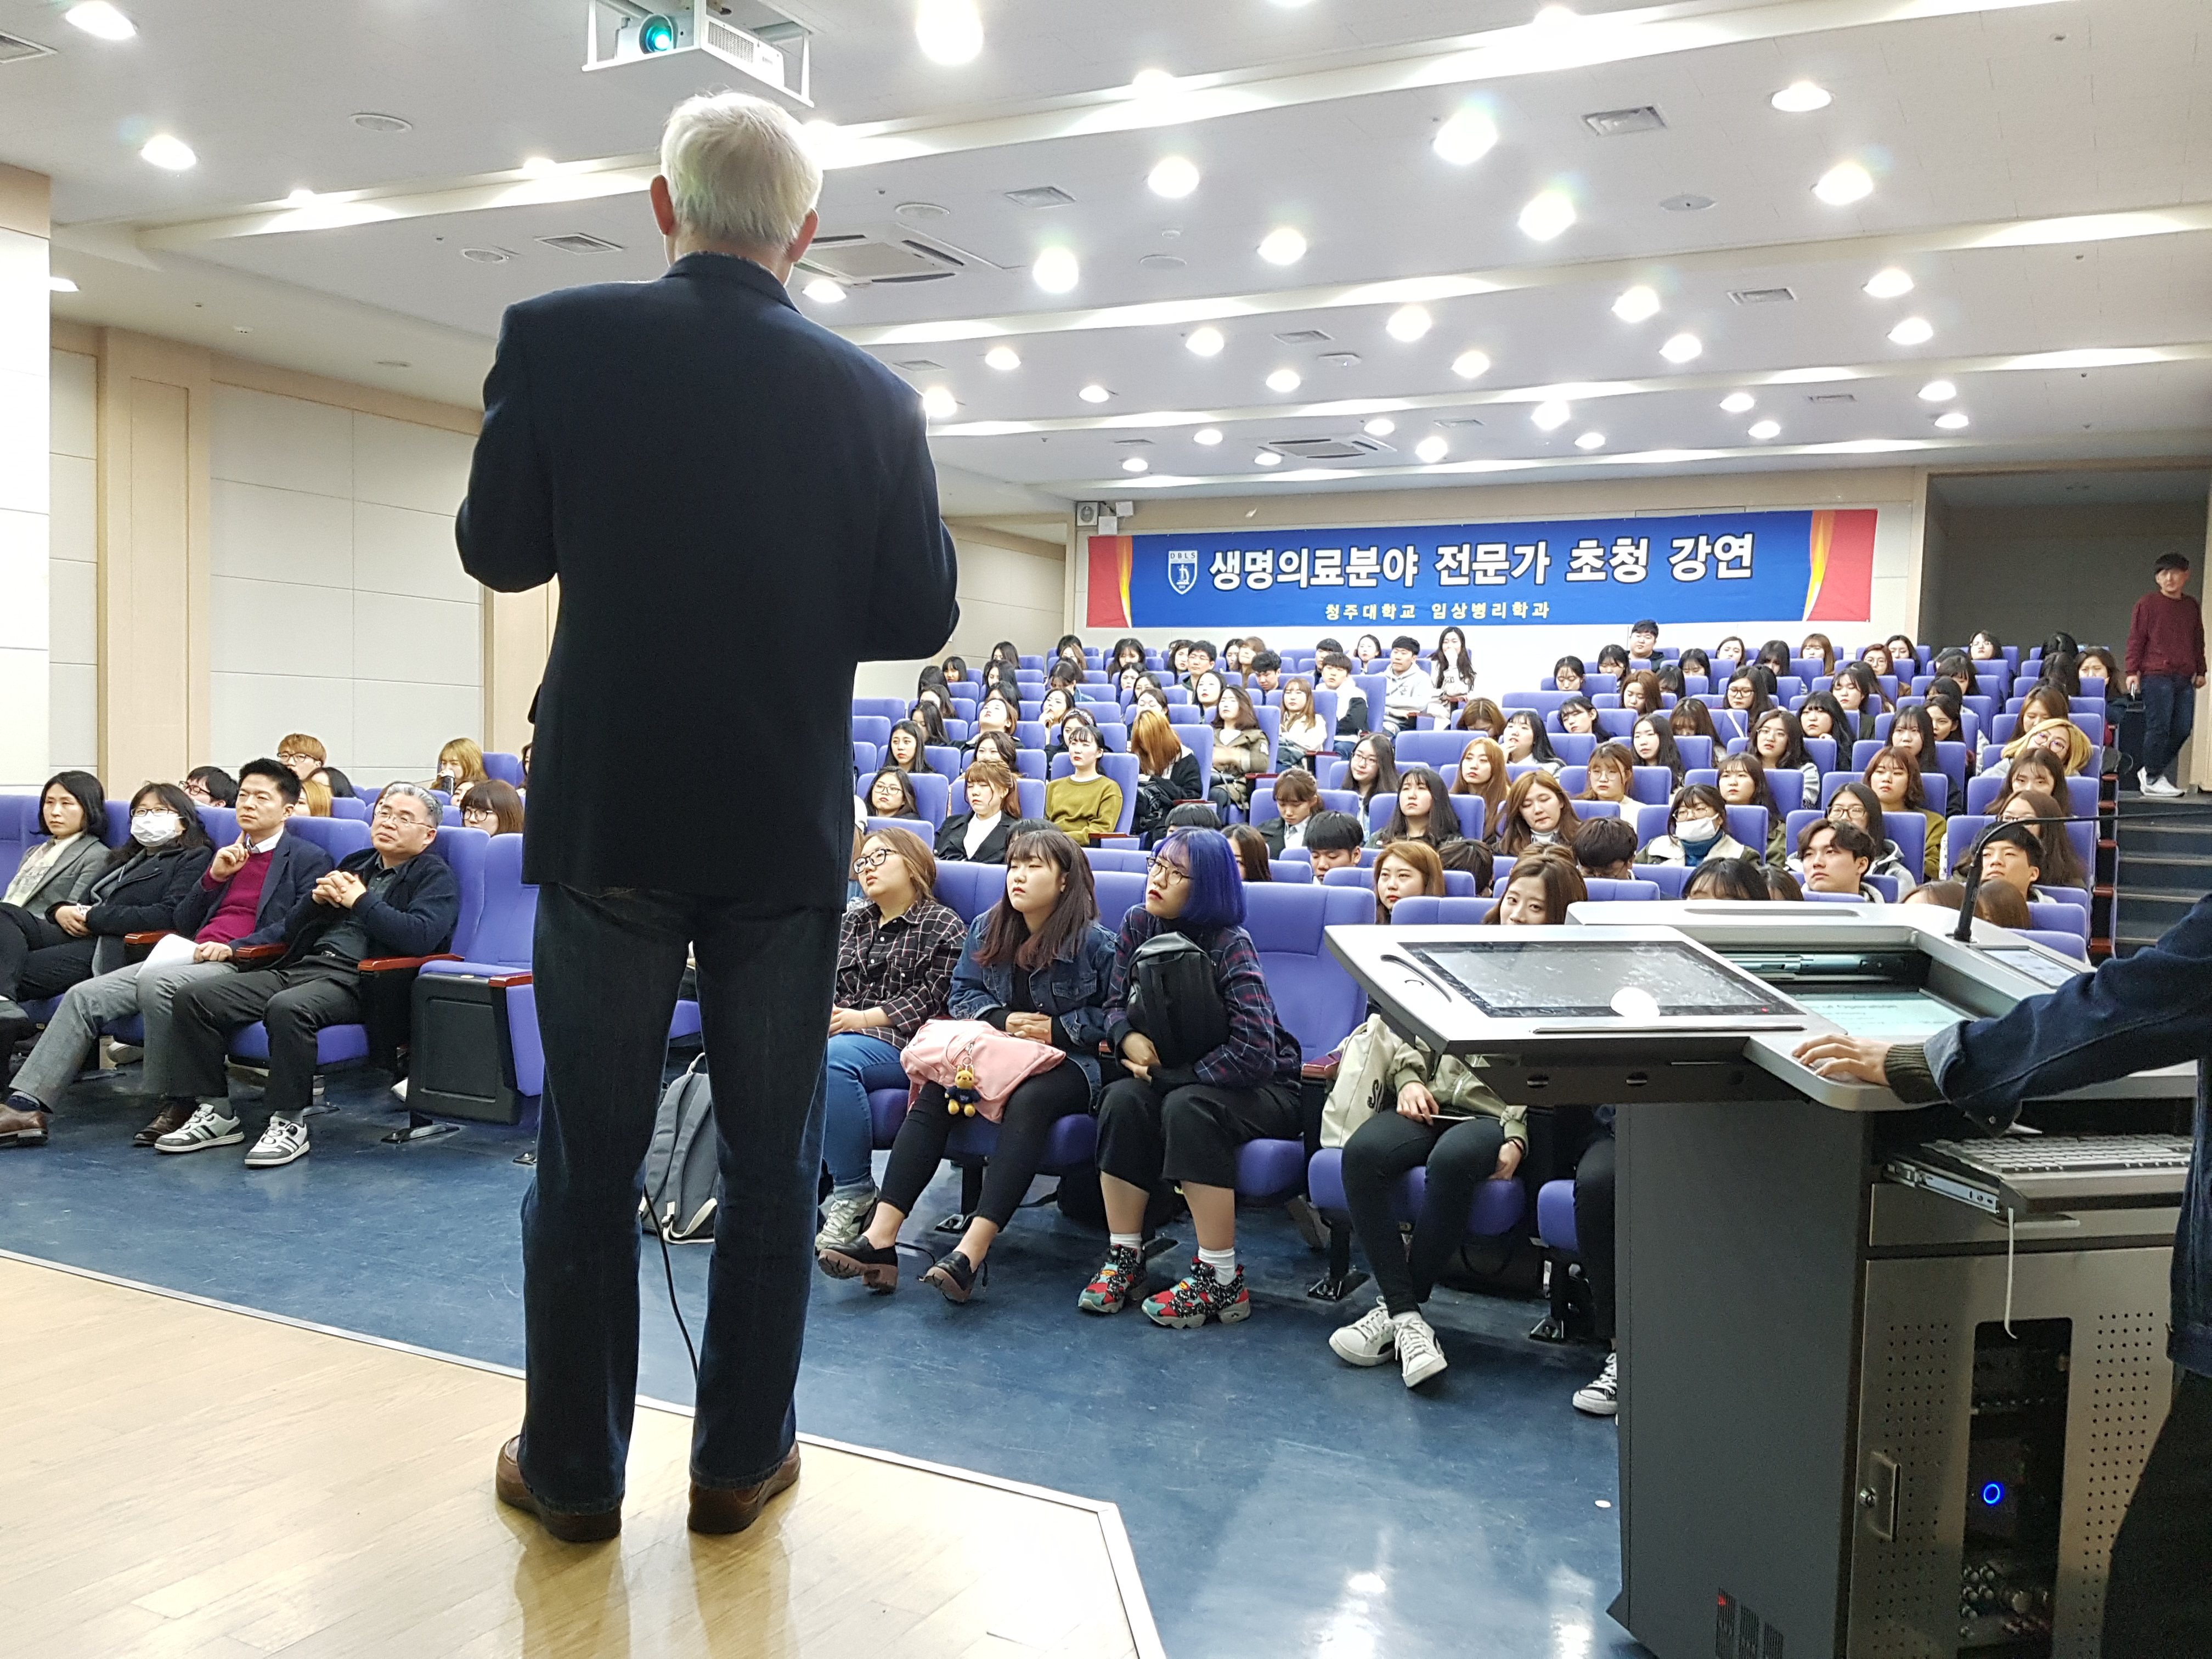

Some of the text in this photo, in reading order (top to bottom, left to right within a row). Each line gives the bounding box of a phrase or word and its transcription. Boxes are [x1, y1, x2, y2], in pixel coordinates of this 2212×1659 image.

[1209, 533, 1754, 591] 생명의료분야 전문가 초청 강연
[1325, 601, 1550, 620] 청주대학교 임상병리학과
